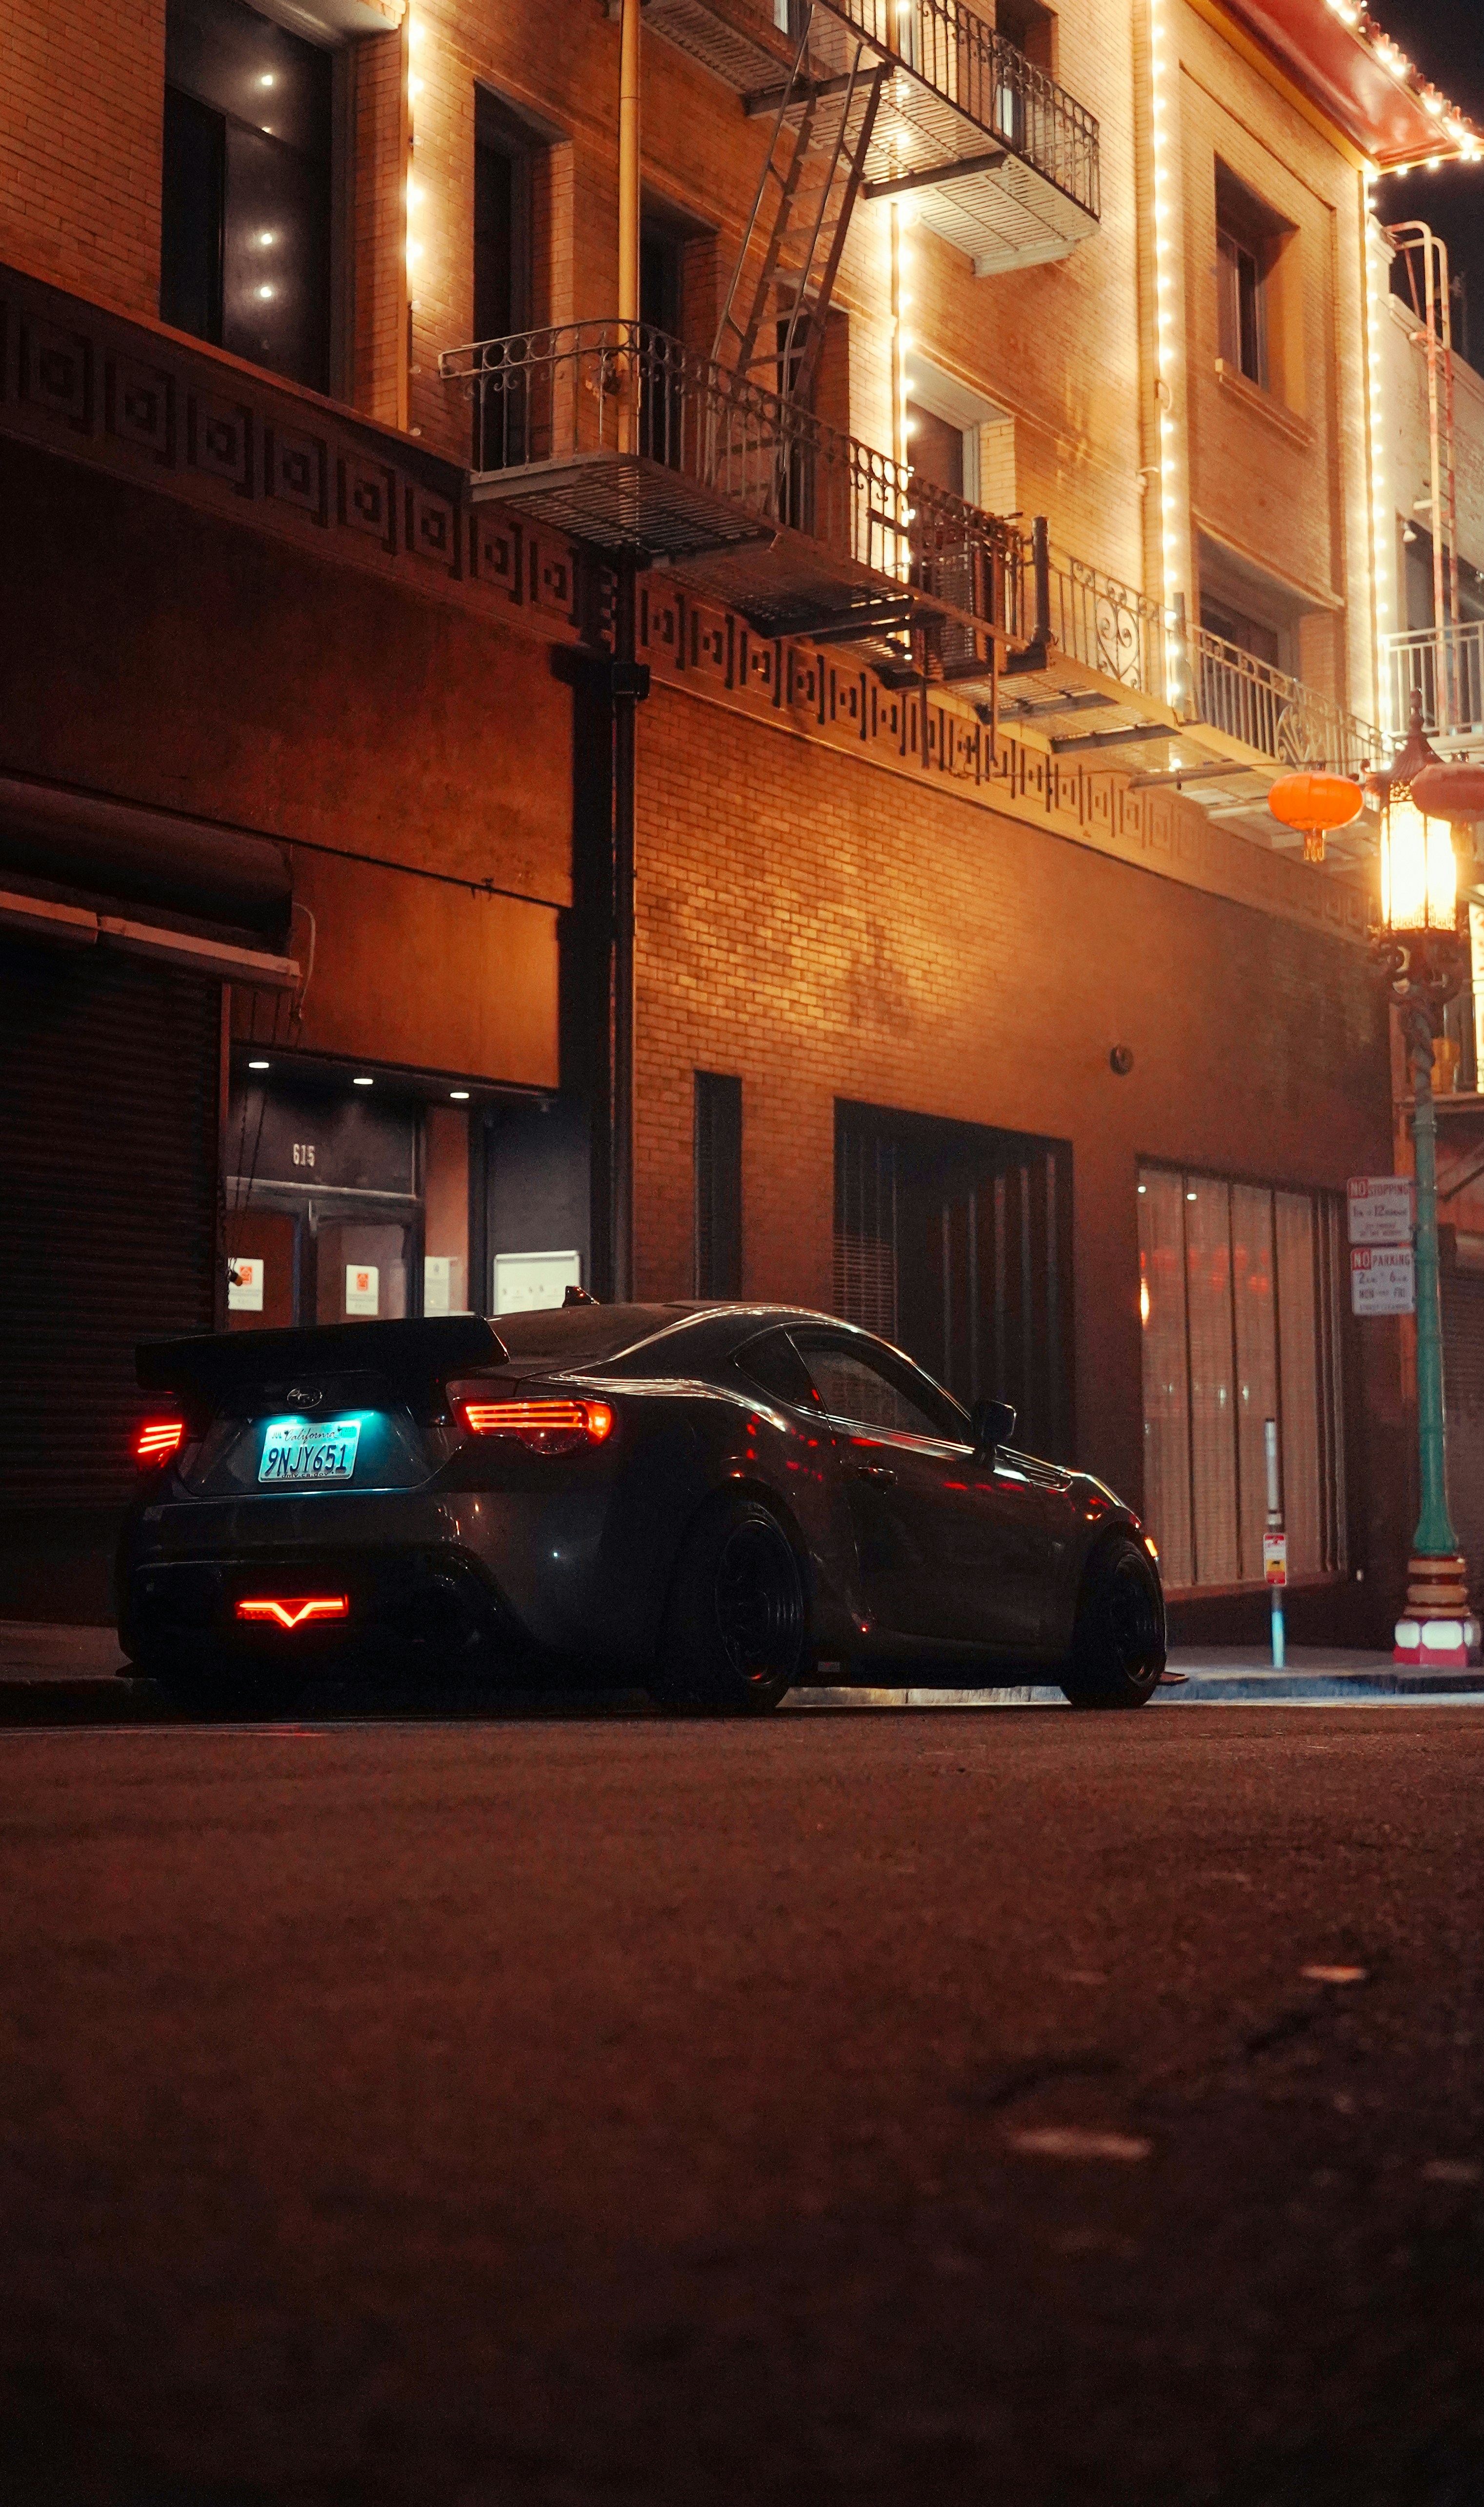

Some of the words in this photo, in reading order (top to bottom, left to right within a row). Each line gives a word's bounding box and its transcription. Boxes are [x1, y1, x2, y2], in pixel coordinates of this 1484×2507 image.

[294, 1143, 315, 1167] 615
[1350, 1181, 1366, 1197] NO
[1368, 1184, 1409, 1196] STOPPING
[1354, 1251, 1370, 1268] NO
[1372, 1254, 1410, 1266] PARKING
[284, 1428, 341, 1444] California
[264, 1444, 347, 1475] 9NJY651
